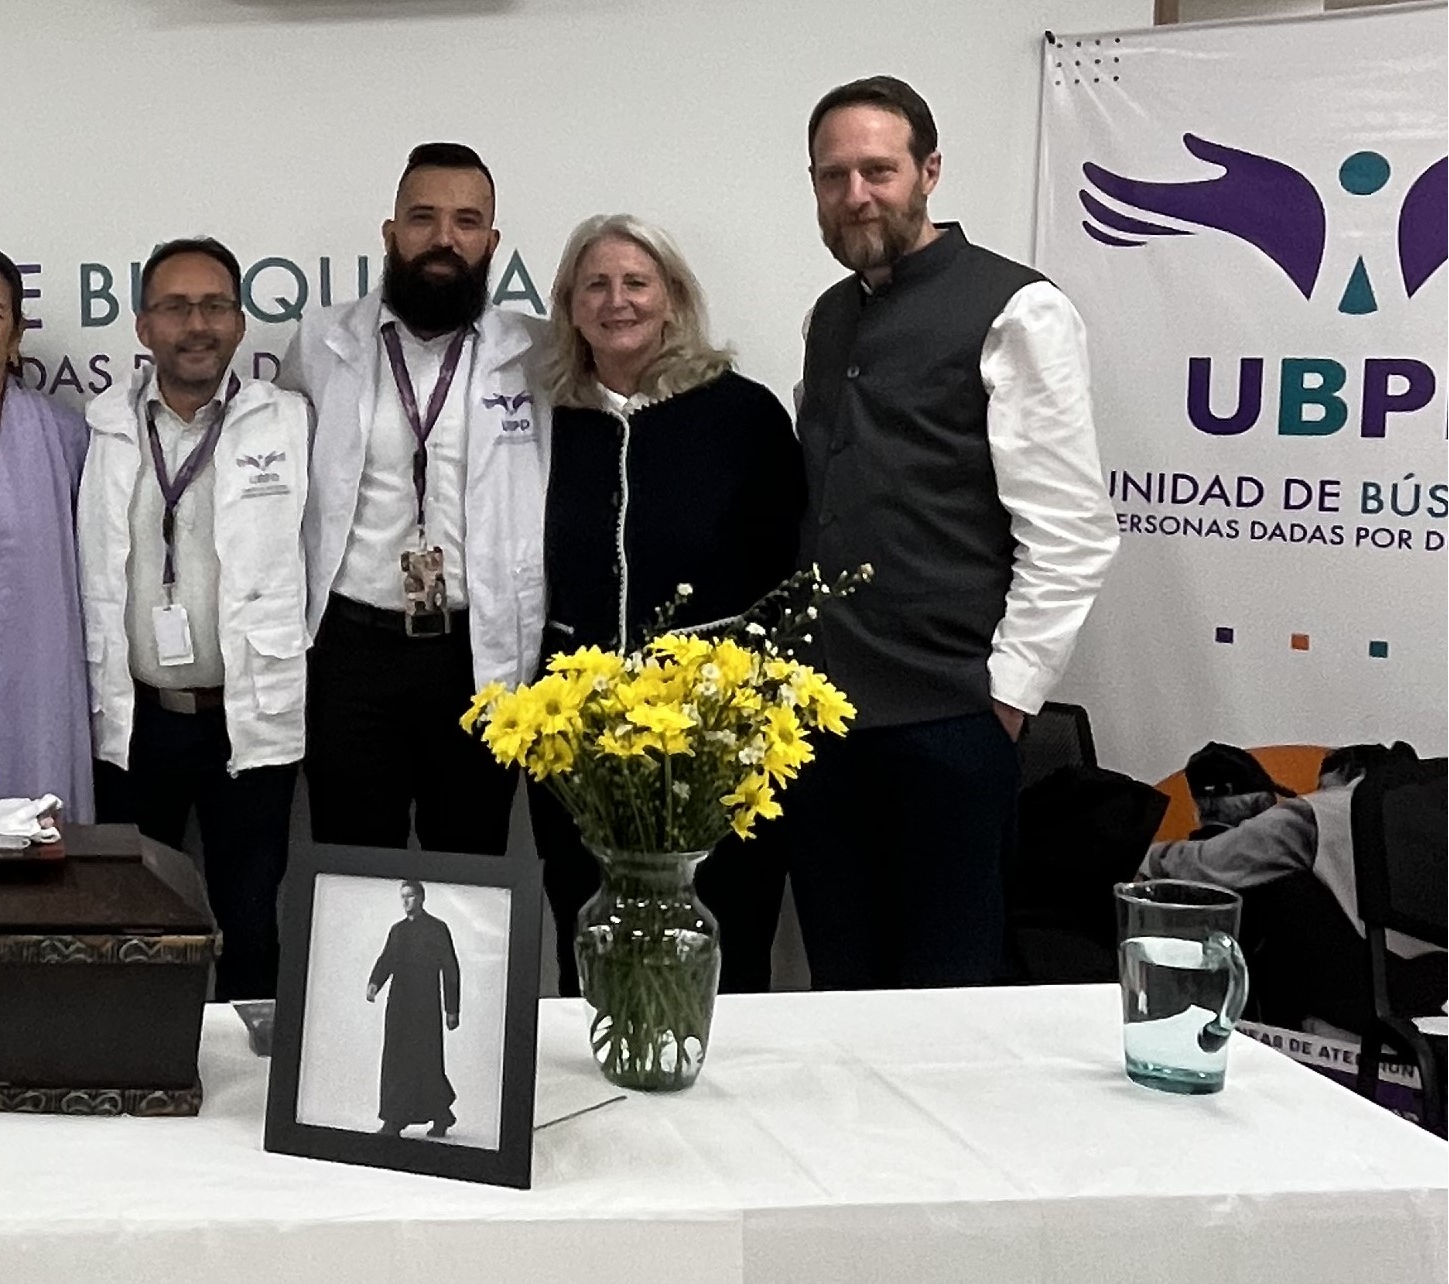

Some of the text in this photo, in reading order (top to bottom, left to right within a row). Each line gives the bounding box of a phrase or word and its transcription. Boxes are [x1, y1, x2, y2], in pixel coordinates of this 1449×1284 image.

[1187, 357, 1448, 440] UBP
[1283, 478, 1341, 512] DE
[1116, 513, 1240, 540] ERSONAS
[1250, 520, 1345, 546] DADAS
[1355, 526, 1413, 550] POR
